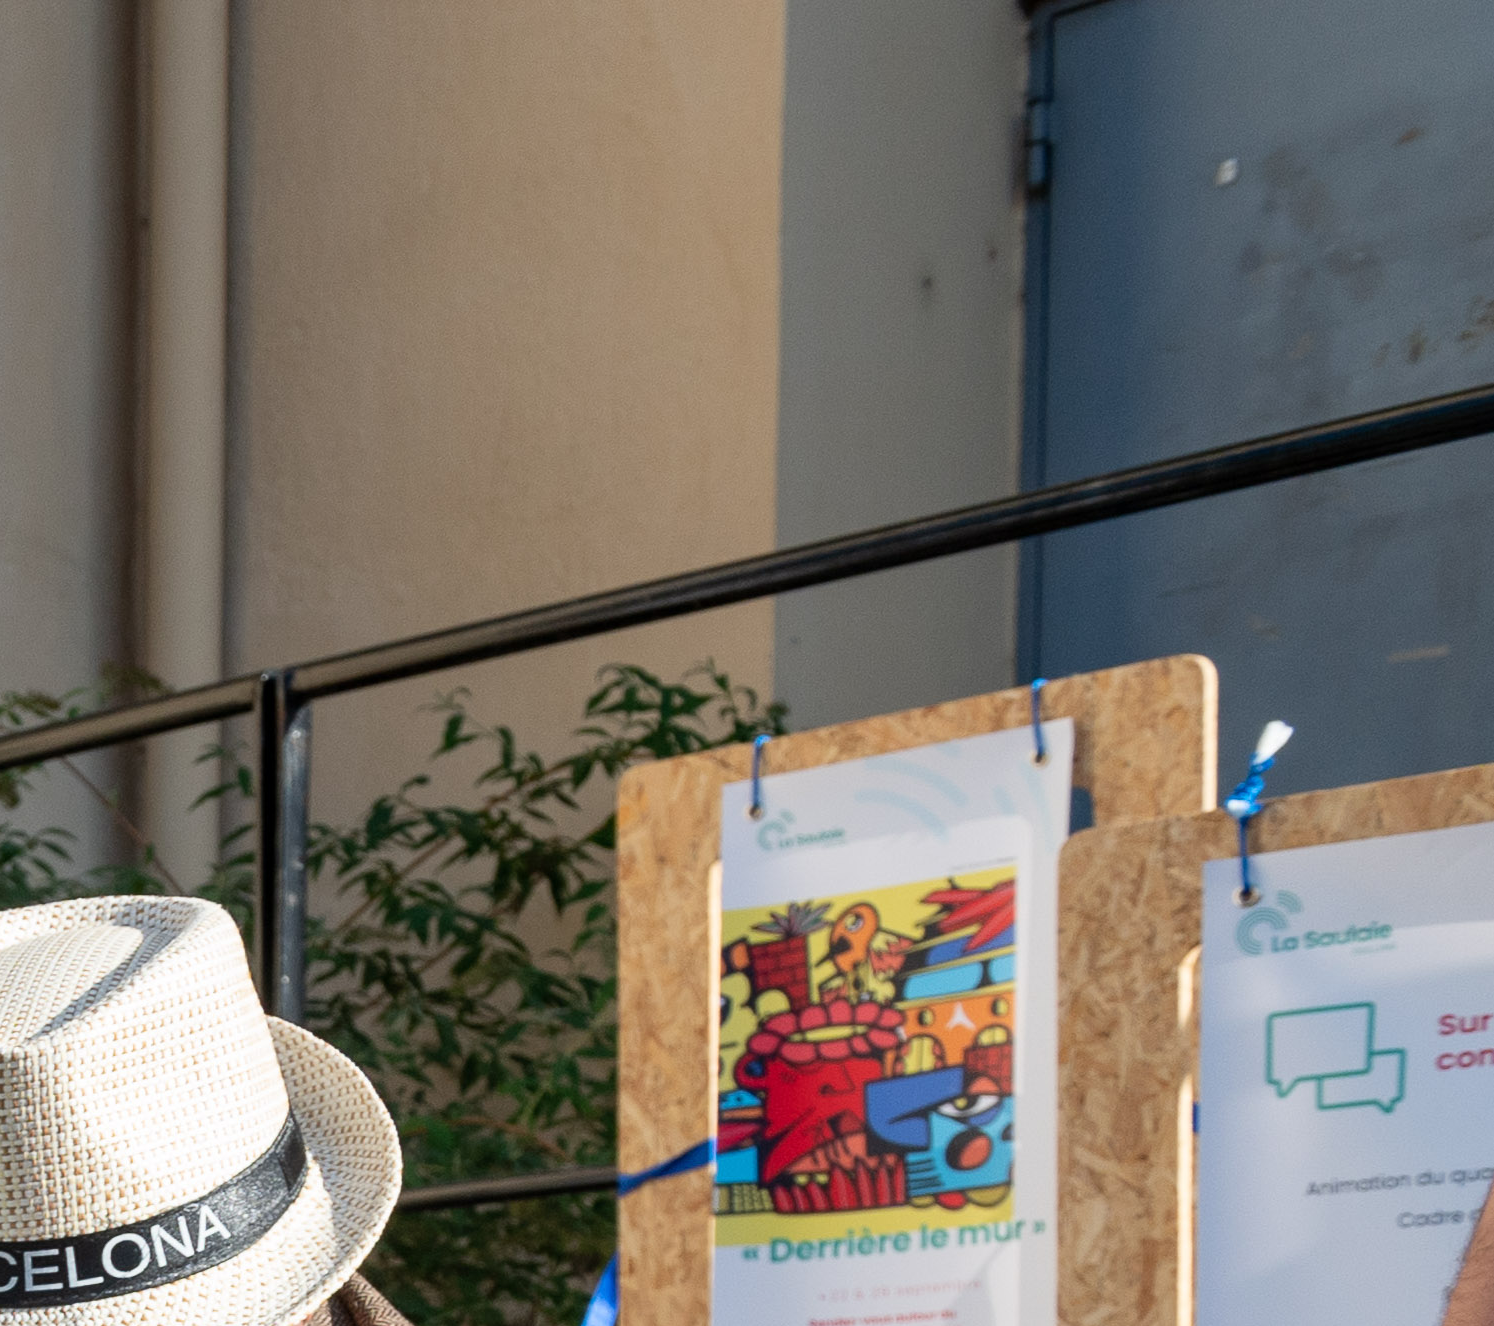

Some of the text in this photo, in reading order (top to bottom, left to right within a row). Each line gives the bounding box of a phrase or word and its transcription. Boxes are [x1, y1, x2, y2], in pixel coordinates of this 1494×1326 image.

[1271, 921, 1393, 953] La Saulaie
[1437, 1012, 1494, 1036] Sur
[1305, 1166, 1494, 1196] Animation du qua
[1396, 1207, 1464, 1229] Cadre
[770, 1226, 911, 1263] Derrière
[920, 1223, 949, 1249] le
[957, 1218, 1024, 1246] mur
